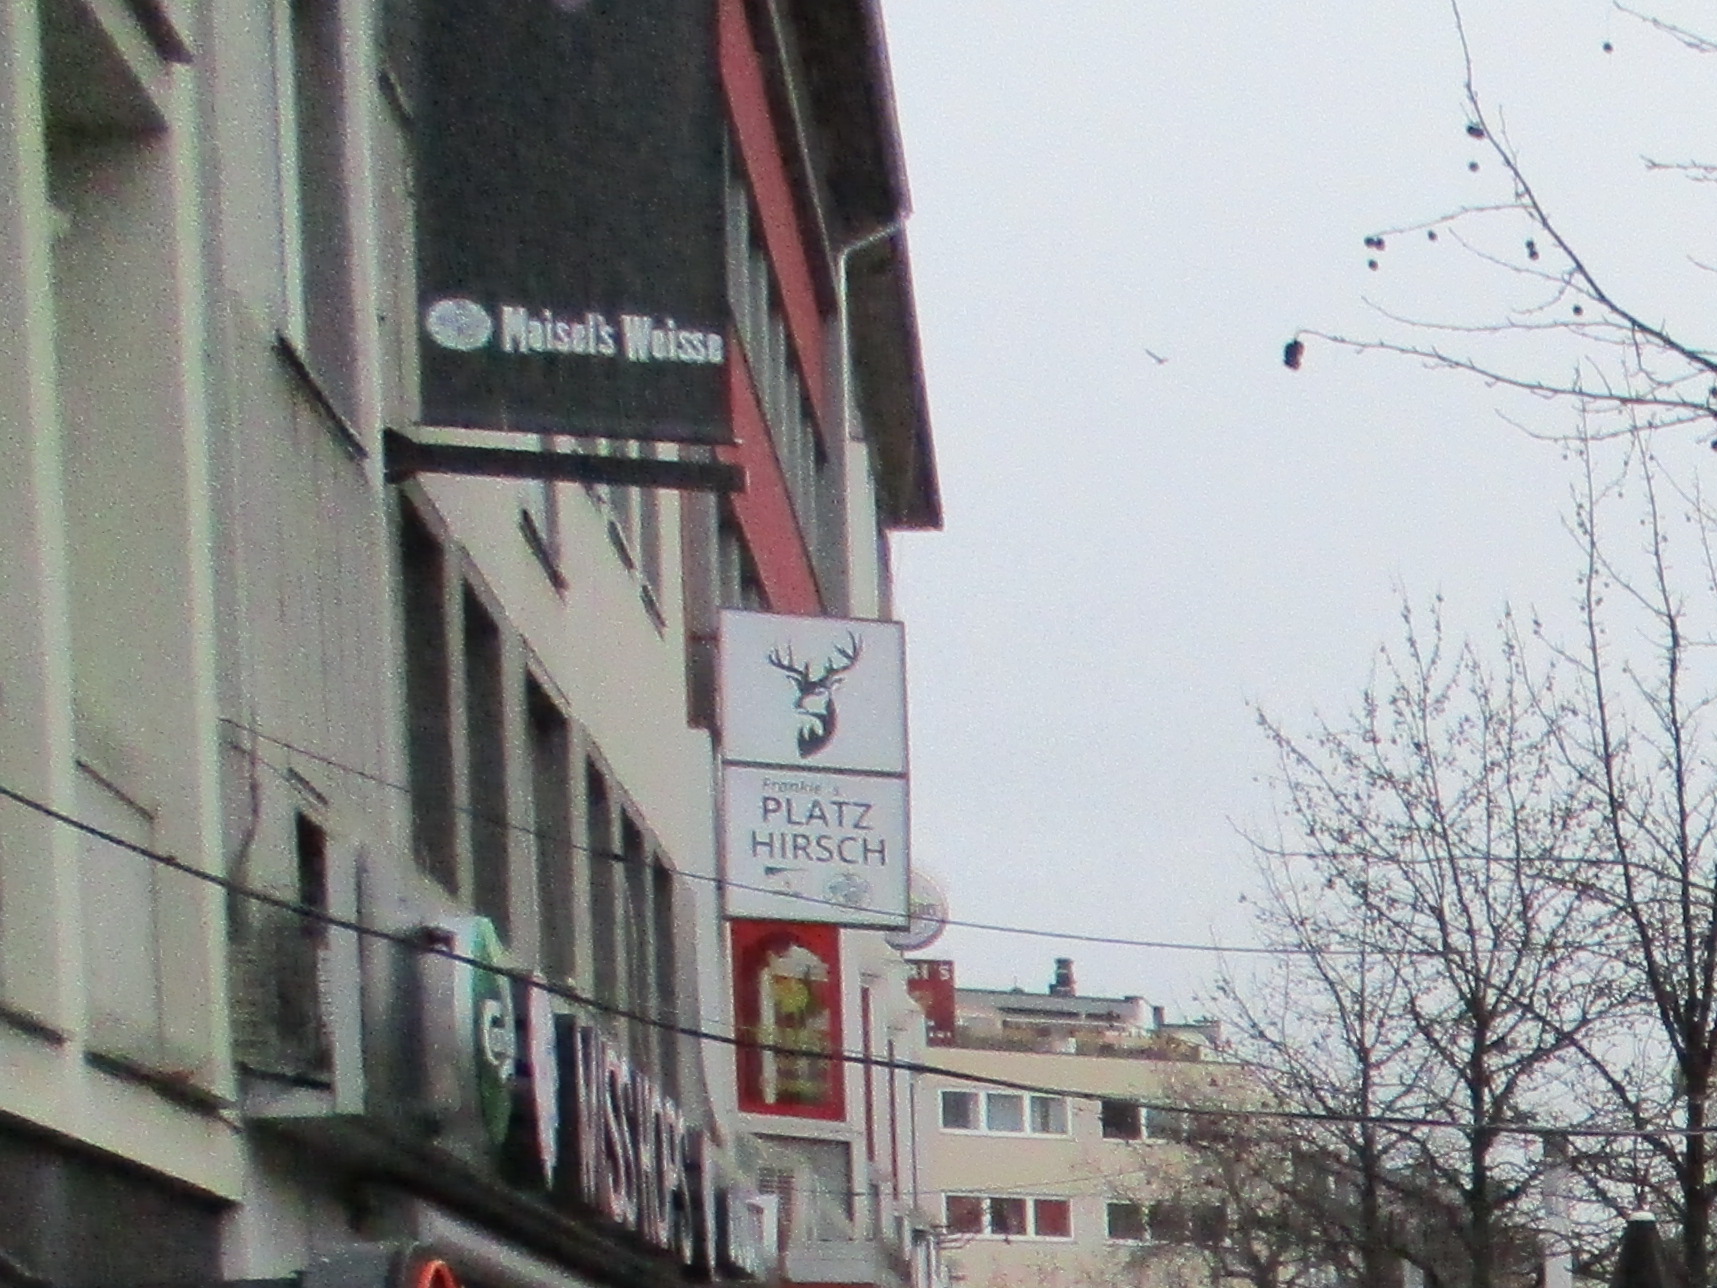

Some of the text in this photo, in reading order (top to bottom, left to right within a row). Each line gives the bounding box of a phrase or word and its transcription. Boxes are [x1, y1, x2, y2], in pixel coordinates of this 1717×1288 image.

[622, 317, 724, 364] Weisse
[761, 795, 873, 831] PLATZ
[752, 830, 886, 866] HIRSCH
